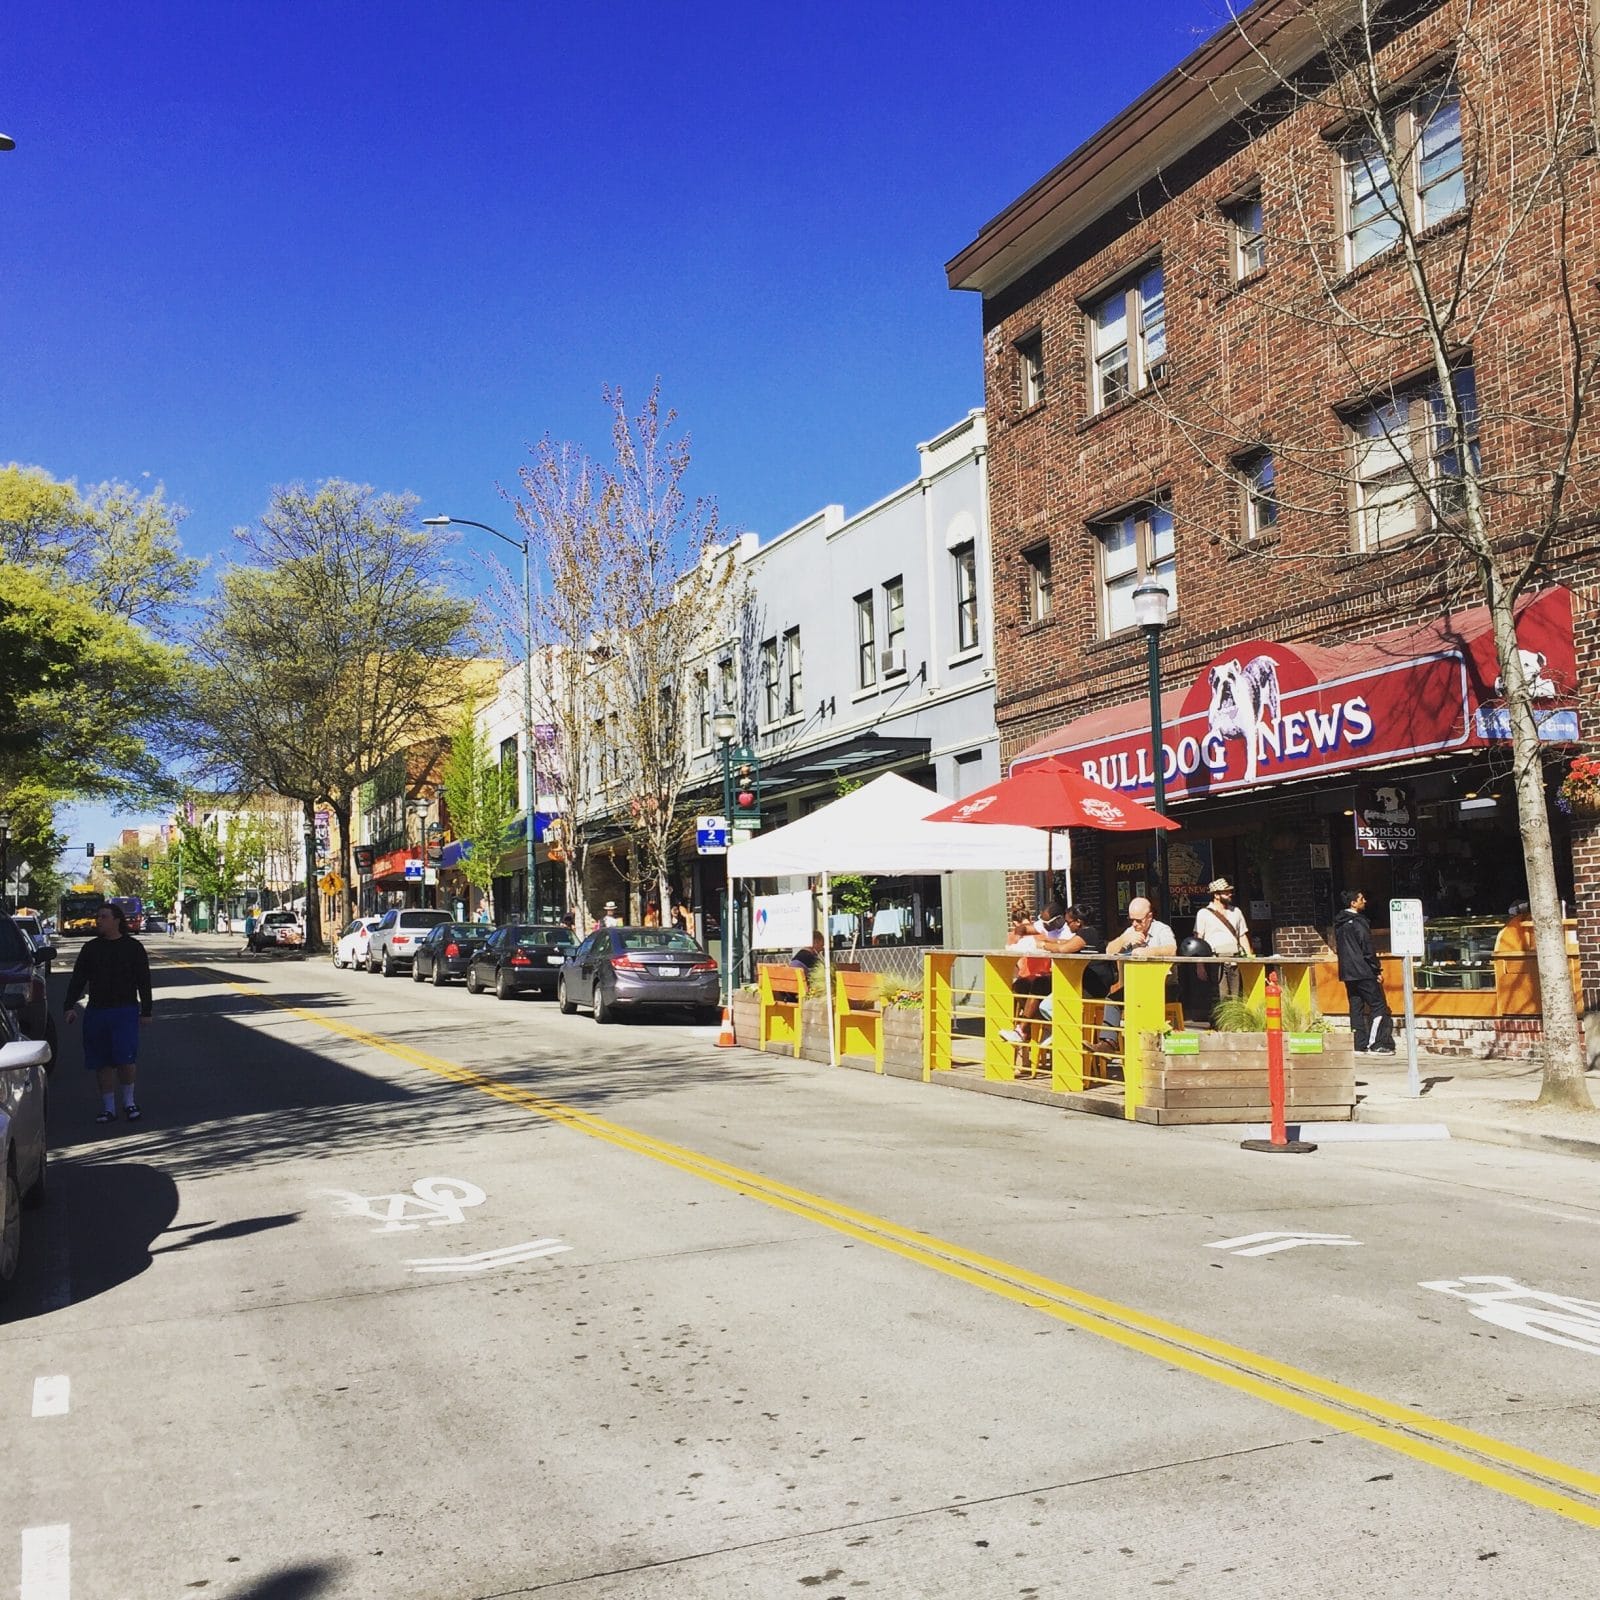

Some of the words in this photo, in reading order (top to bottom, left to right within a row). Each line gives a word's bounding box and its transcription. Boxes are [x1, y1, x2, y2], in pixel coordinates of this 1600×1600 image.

[1082, 729, 1228, 790] BULLDOG
[1256, 695, 1374, 762] NEWS
[708, 830, 716, 840] 2
[1358, 827, 1416, 837] ESPRESSO
[1367, 839, 1409, 850] NEWS
